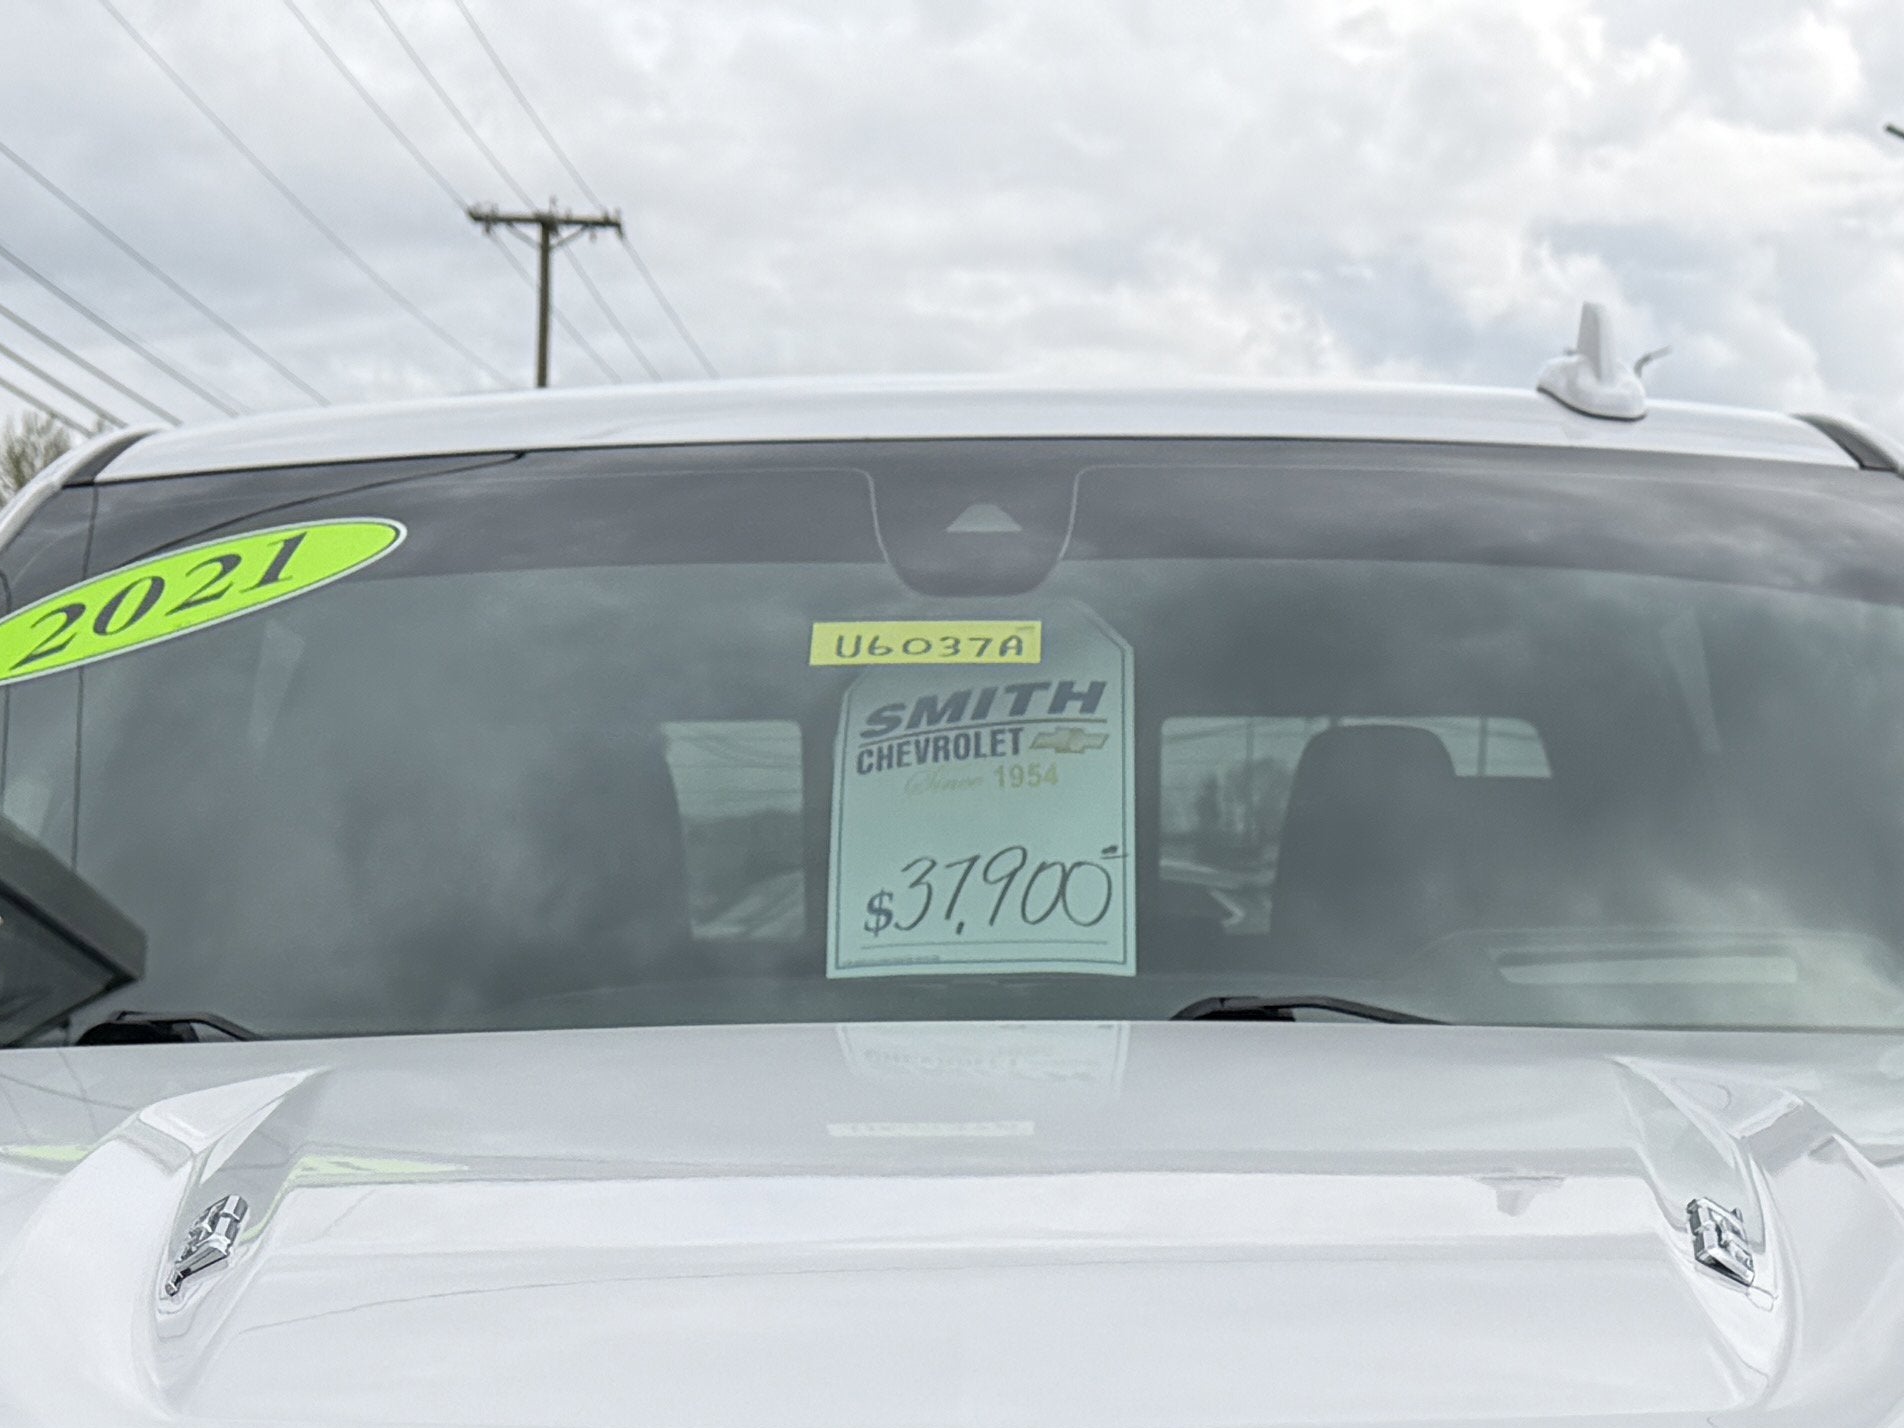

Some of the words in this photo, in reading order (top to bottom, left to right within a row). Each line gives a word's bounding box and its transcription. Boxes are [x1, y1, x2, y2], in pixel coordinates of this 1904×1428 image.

[9, 531, 308, 670] 2021
[836, 634, 1025, 658] U6037A
[859, 680, 1108, 739] SMITH
[856, 727, 1025, 775] CHEVROLET
[994, 763, 1059, 790] 1954
